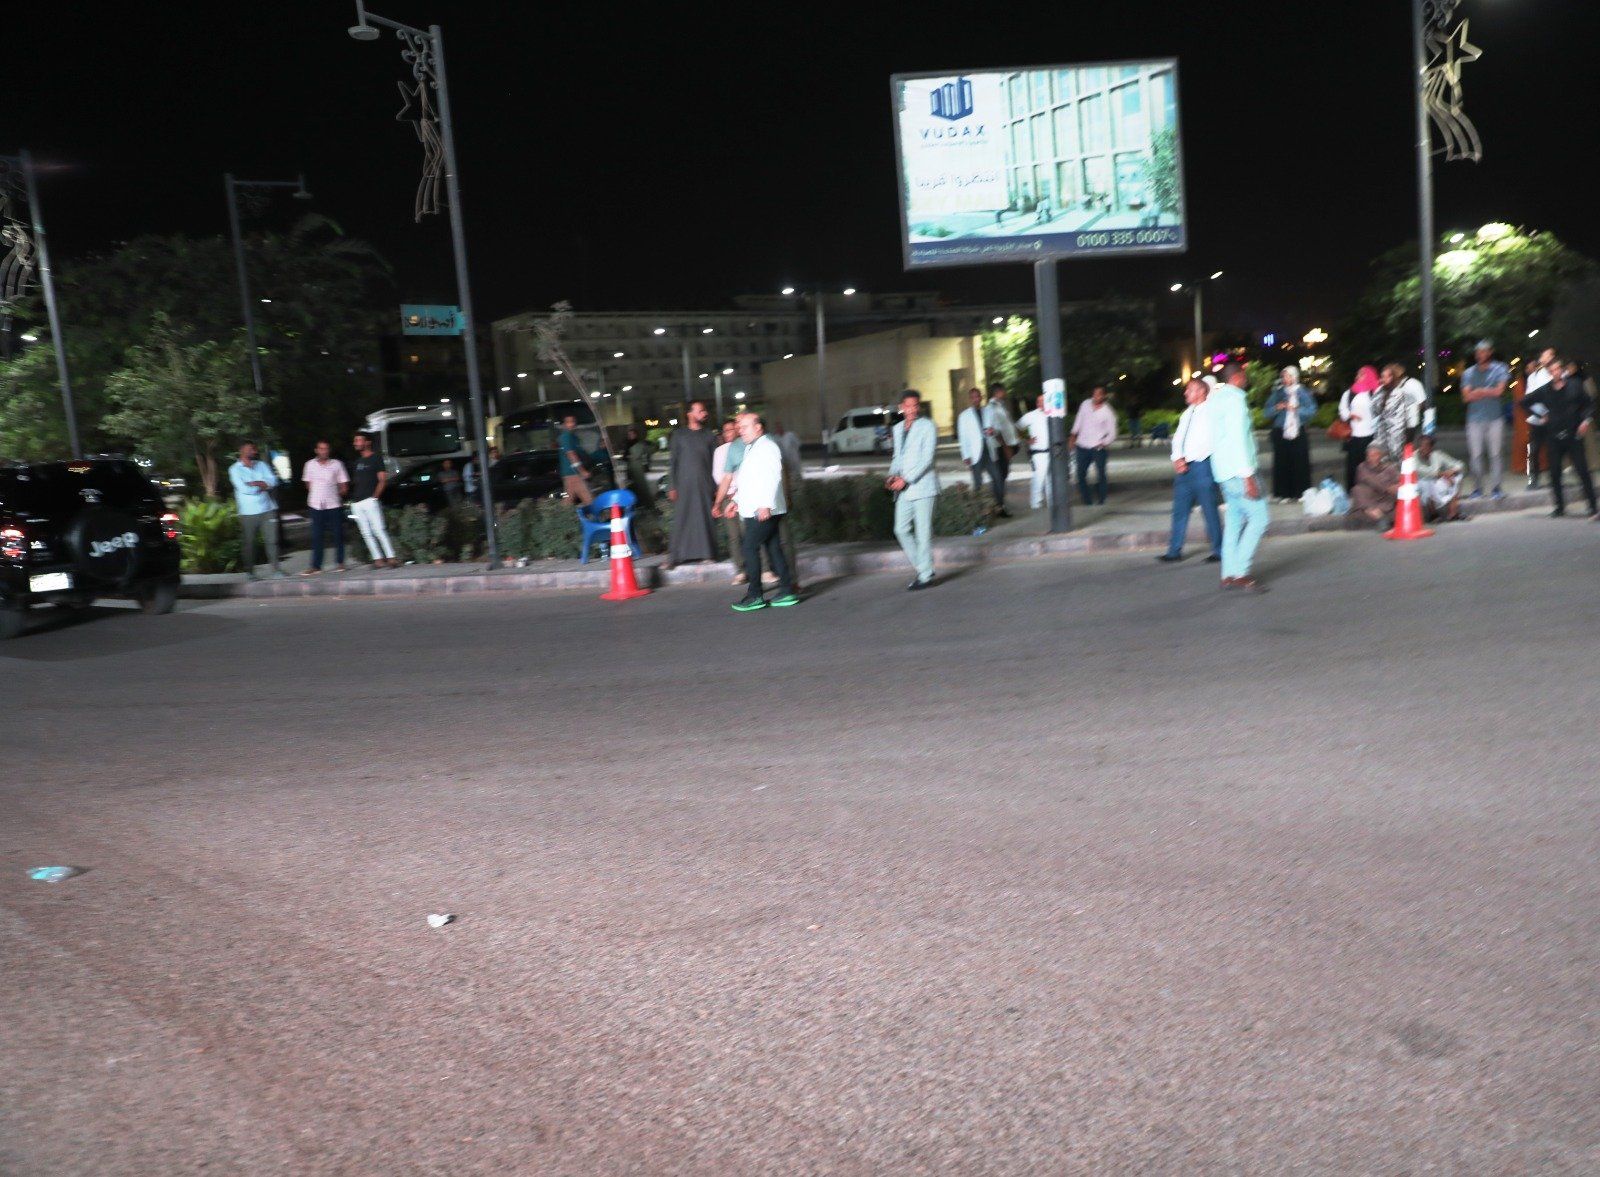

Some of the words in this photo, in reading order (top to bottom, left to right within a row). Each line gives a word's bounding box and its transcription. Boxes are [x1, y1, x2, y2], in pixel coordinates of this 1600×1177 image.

[920, 124, 985, 139] VUDAX
[1076, 232, 1109, 248] 0100
[89, 531, 140, 558] Jeep
